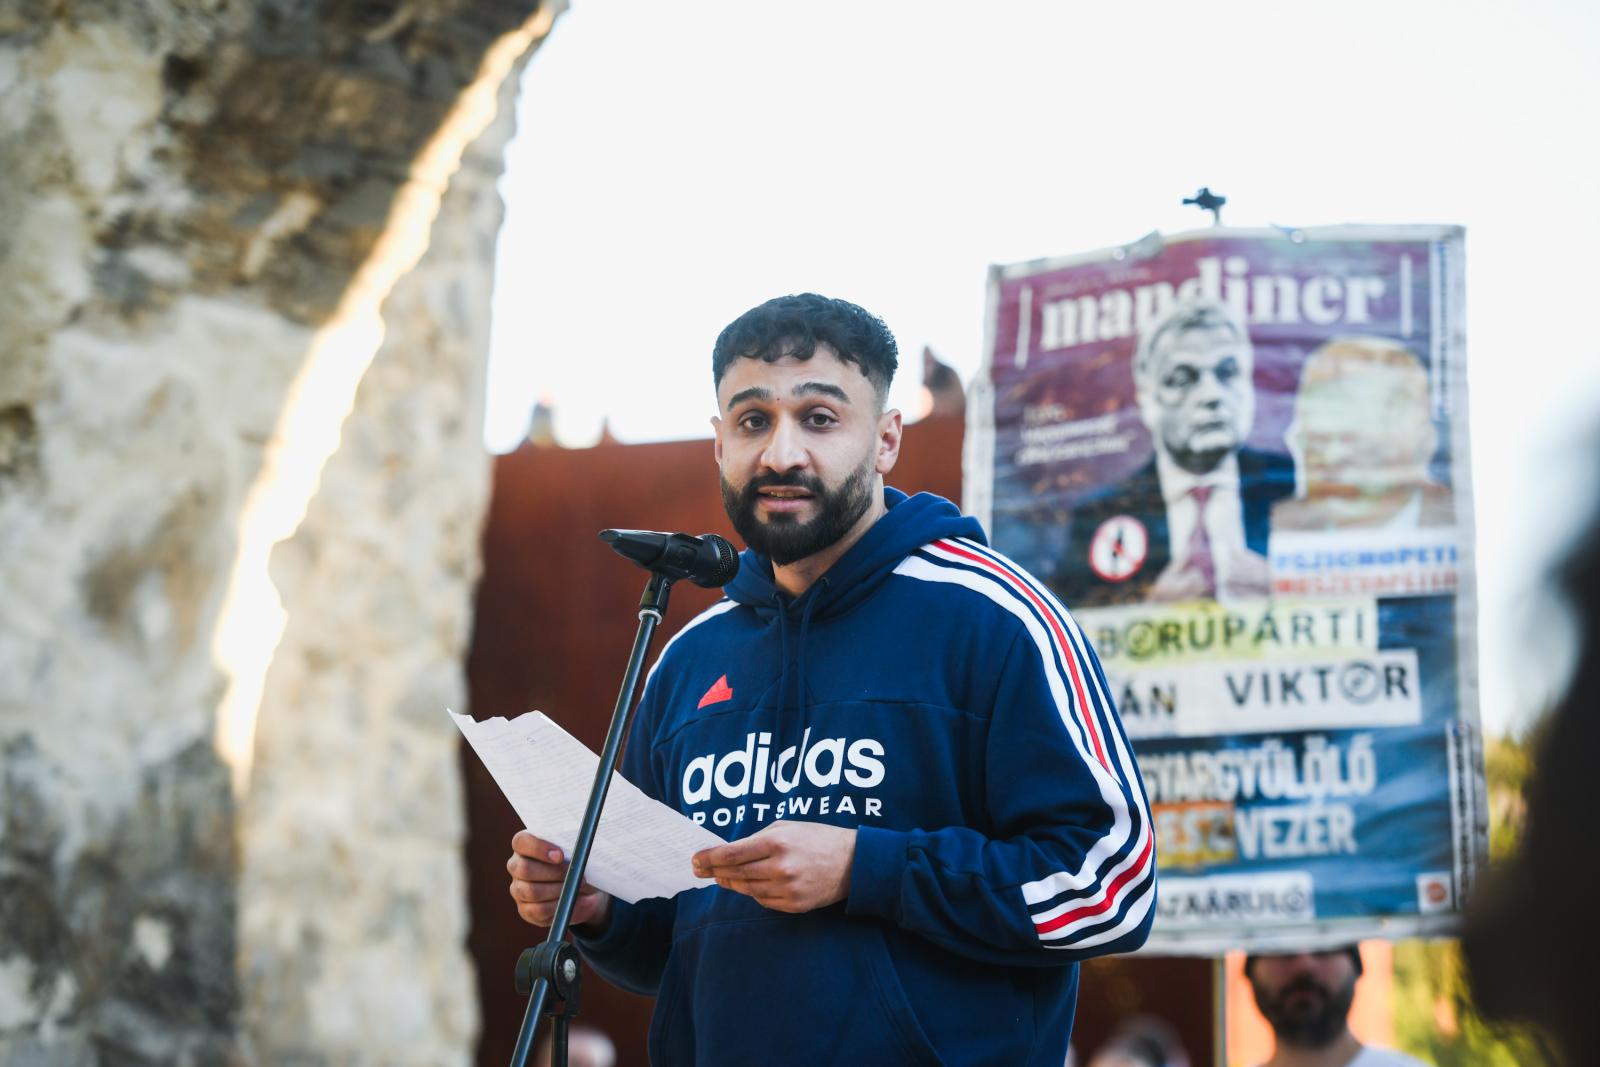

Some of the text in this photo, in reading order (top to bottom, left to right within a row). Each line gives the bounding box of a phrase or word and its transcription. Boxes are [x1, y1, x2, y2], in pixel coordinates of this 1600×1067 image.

[1120, 676, 1178, 719] ÁN
[682, 727, 885, 805] adidas
[686, 796, 882, 827] PORTSWEAR
